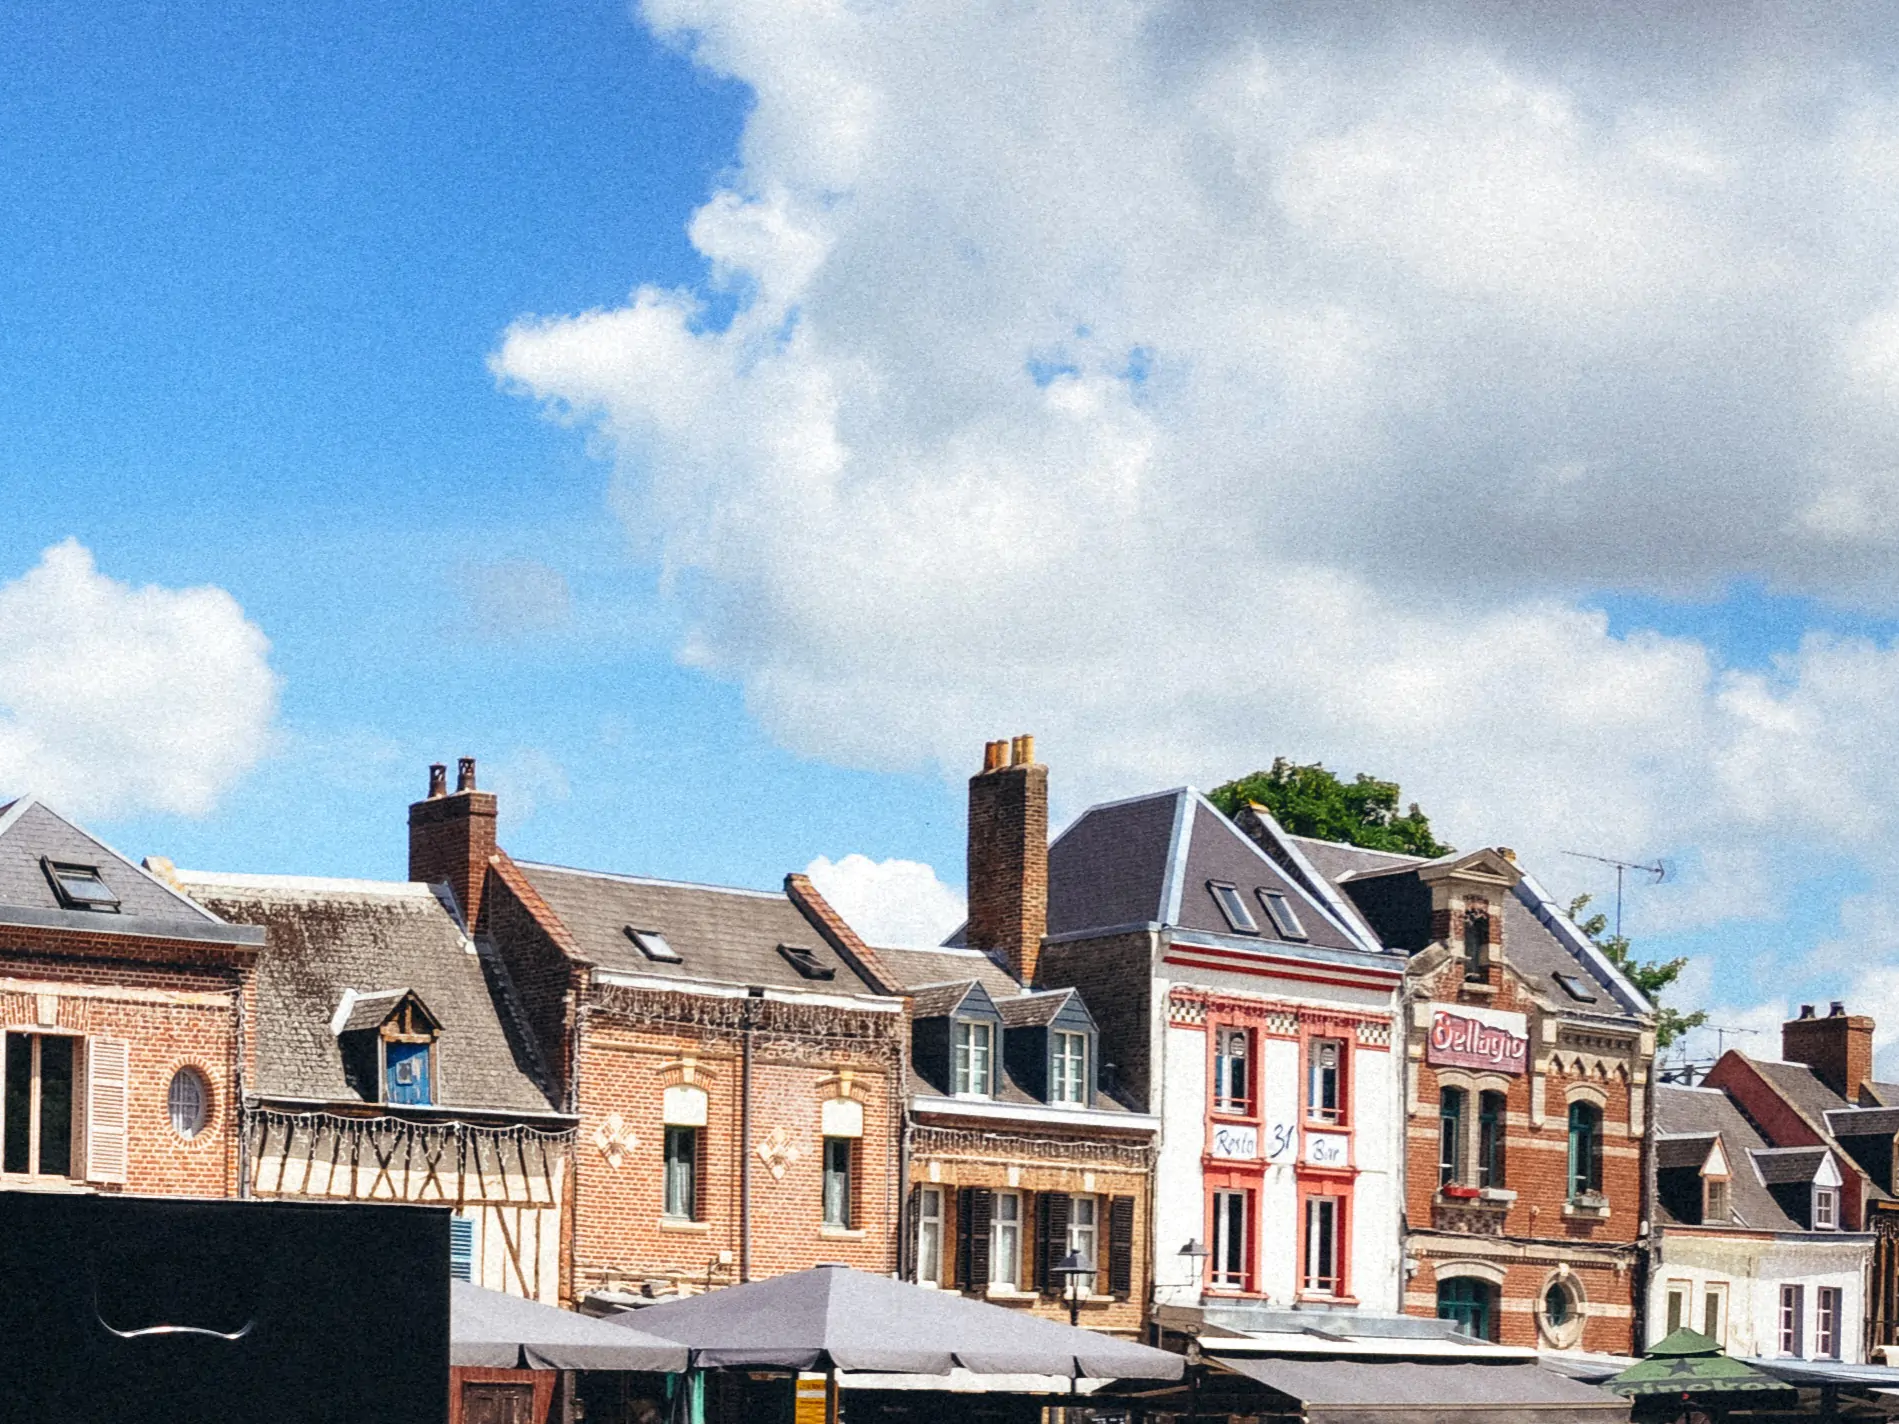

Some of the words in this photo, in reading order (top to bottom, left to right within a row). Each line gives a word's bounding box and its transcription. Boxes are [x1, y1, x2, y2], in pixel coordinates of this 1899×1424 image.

[1433, 1010, 1525, 1064] Bellagio
[1270, 1124, 1295, 1158] 31
[1311, 1138, 1340, 1162] Bar
